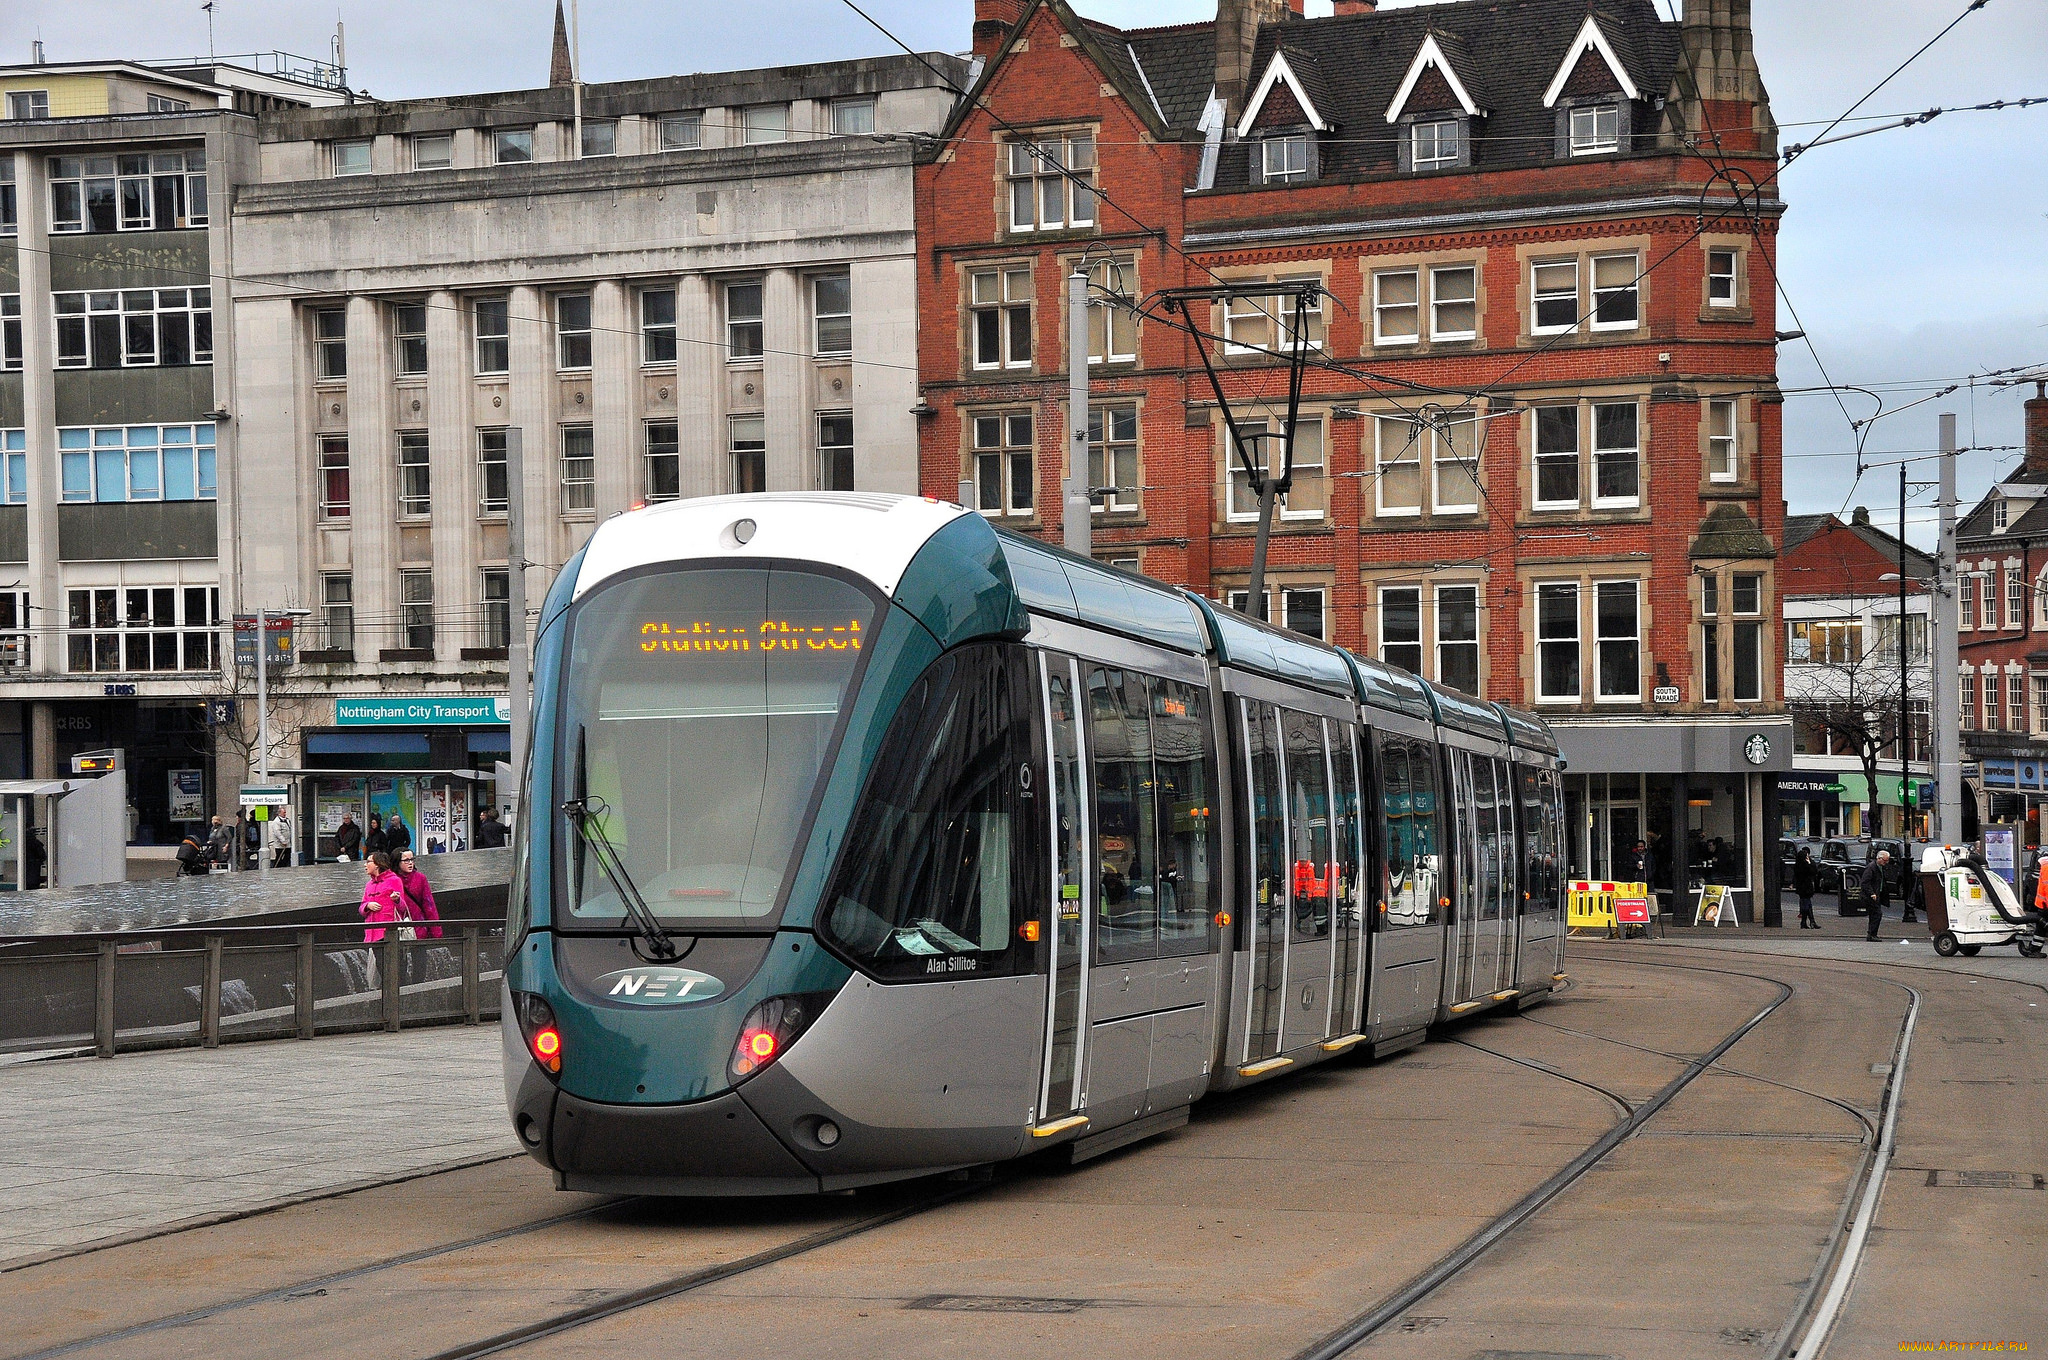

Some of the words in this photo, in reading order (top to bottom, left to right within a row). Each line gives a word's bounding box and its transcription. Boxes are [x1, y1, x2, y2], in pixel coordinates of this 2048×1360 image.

[641, 622, 749, 652] Station
[760, 620, 861, 650] Street
[115, 684, 136, 695] RBS
[339, 706, 405, 720] Nottingham
[408, 705, 431, 719] City
[433, 705, 490, 719] Transport
[498, 710, 511, 718] Tra
[68, 717, 92, 730] RBS
[1778, 781, 1808, 790] AMERICA
[423, 809, 446, 818] inside
[423, 817, 438, 825] out
[423, 822, 446, 832] mind
[926, 958, 947, 974] Alan
[948, 956, 976, 972] Sillitoe
[608, 974, 707, 998] NET
